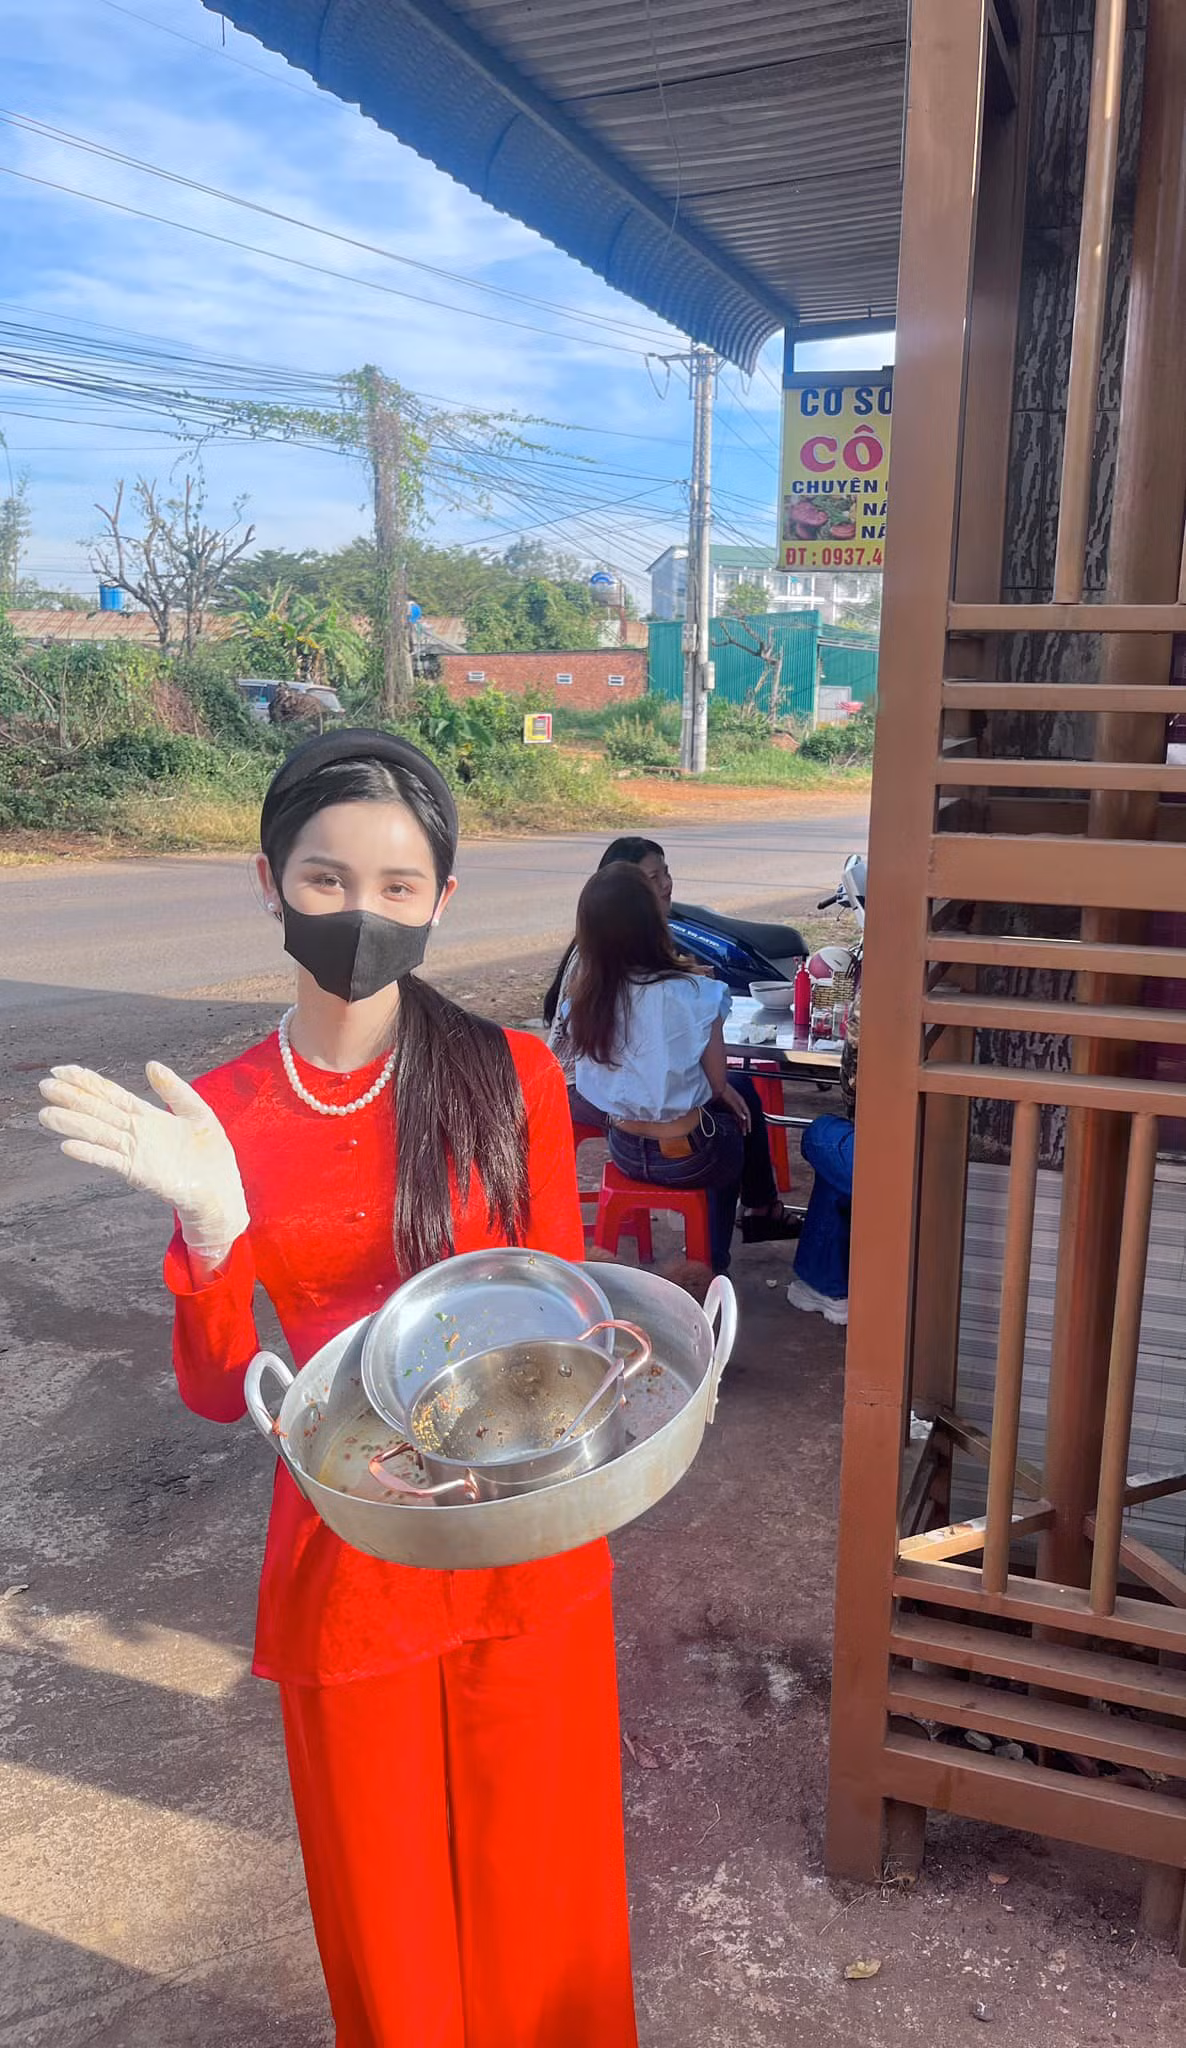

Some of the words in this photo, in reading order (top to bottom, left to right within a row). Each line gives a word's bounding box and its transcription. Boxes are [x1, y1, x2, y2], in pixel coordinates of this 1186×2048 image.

[800, 424, 883, 472] CÔ
[792, 477, 878, 493] CHUYÊN
[822, 547, 882, 565] 0937.4
